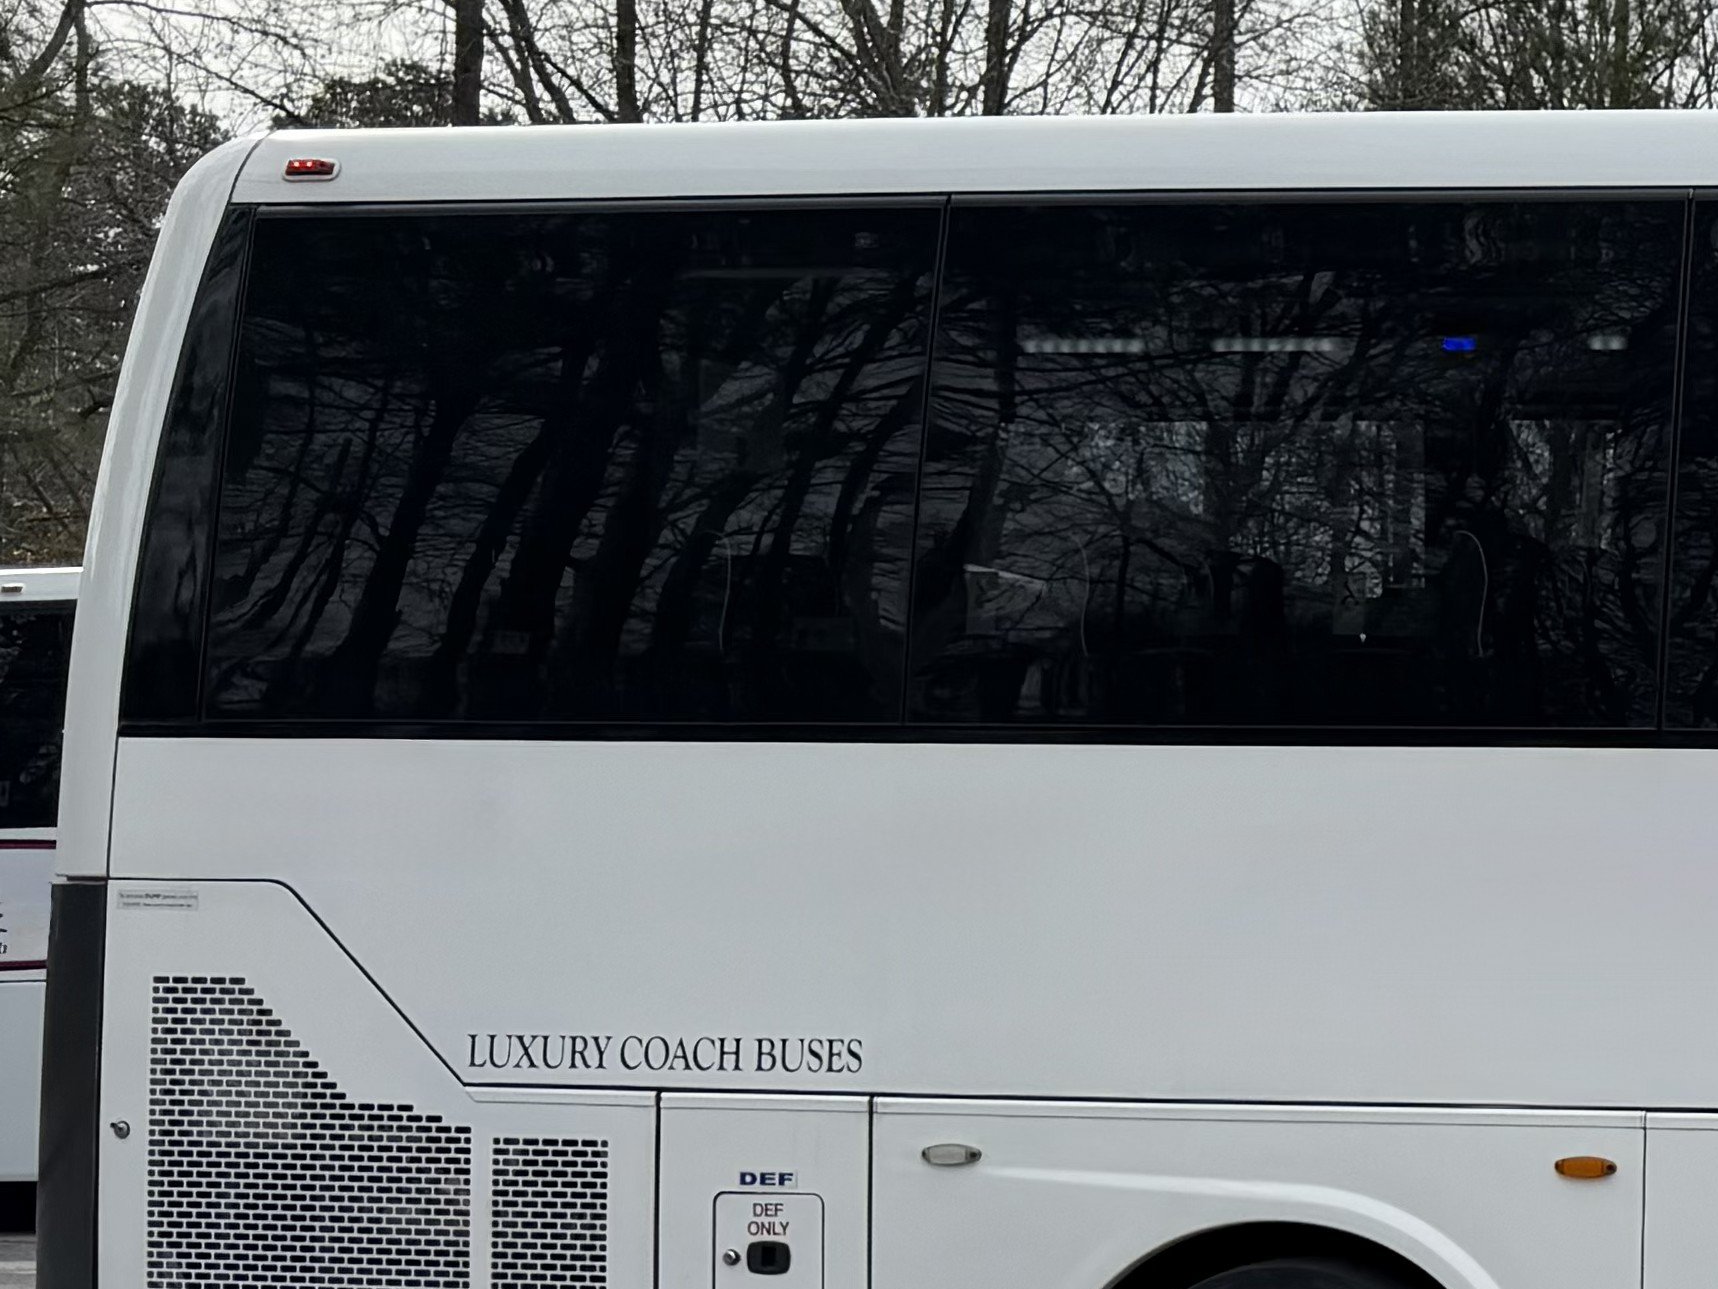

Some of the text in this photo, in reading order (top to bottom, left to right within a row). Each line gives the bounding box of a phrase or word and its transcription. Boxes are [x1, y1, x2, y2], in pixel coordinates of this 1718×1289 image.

[467, 1033, 863, 1073] LUXURY COACH BUSES
[739, 1171, 794, 1186] DEF
[752, 1202, 784, 1217] DEF
[747, 1220, 790, 1236] ONLY
